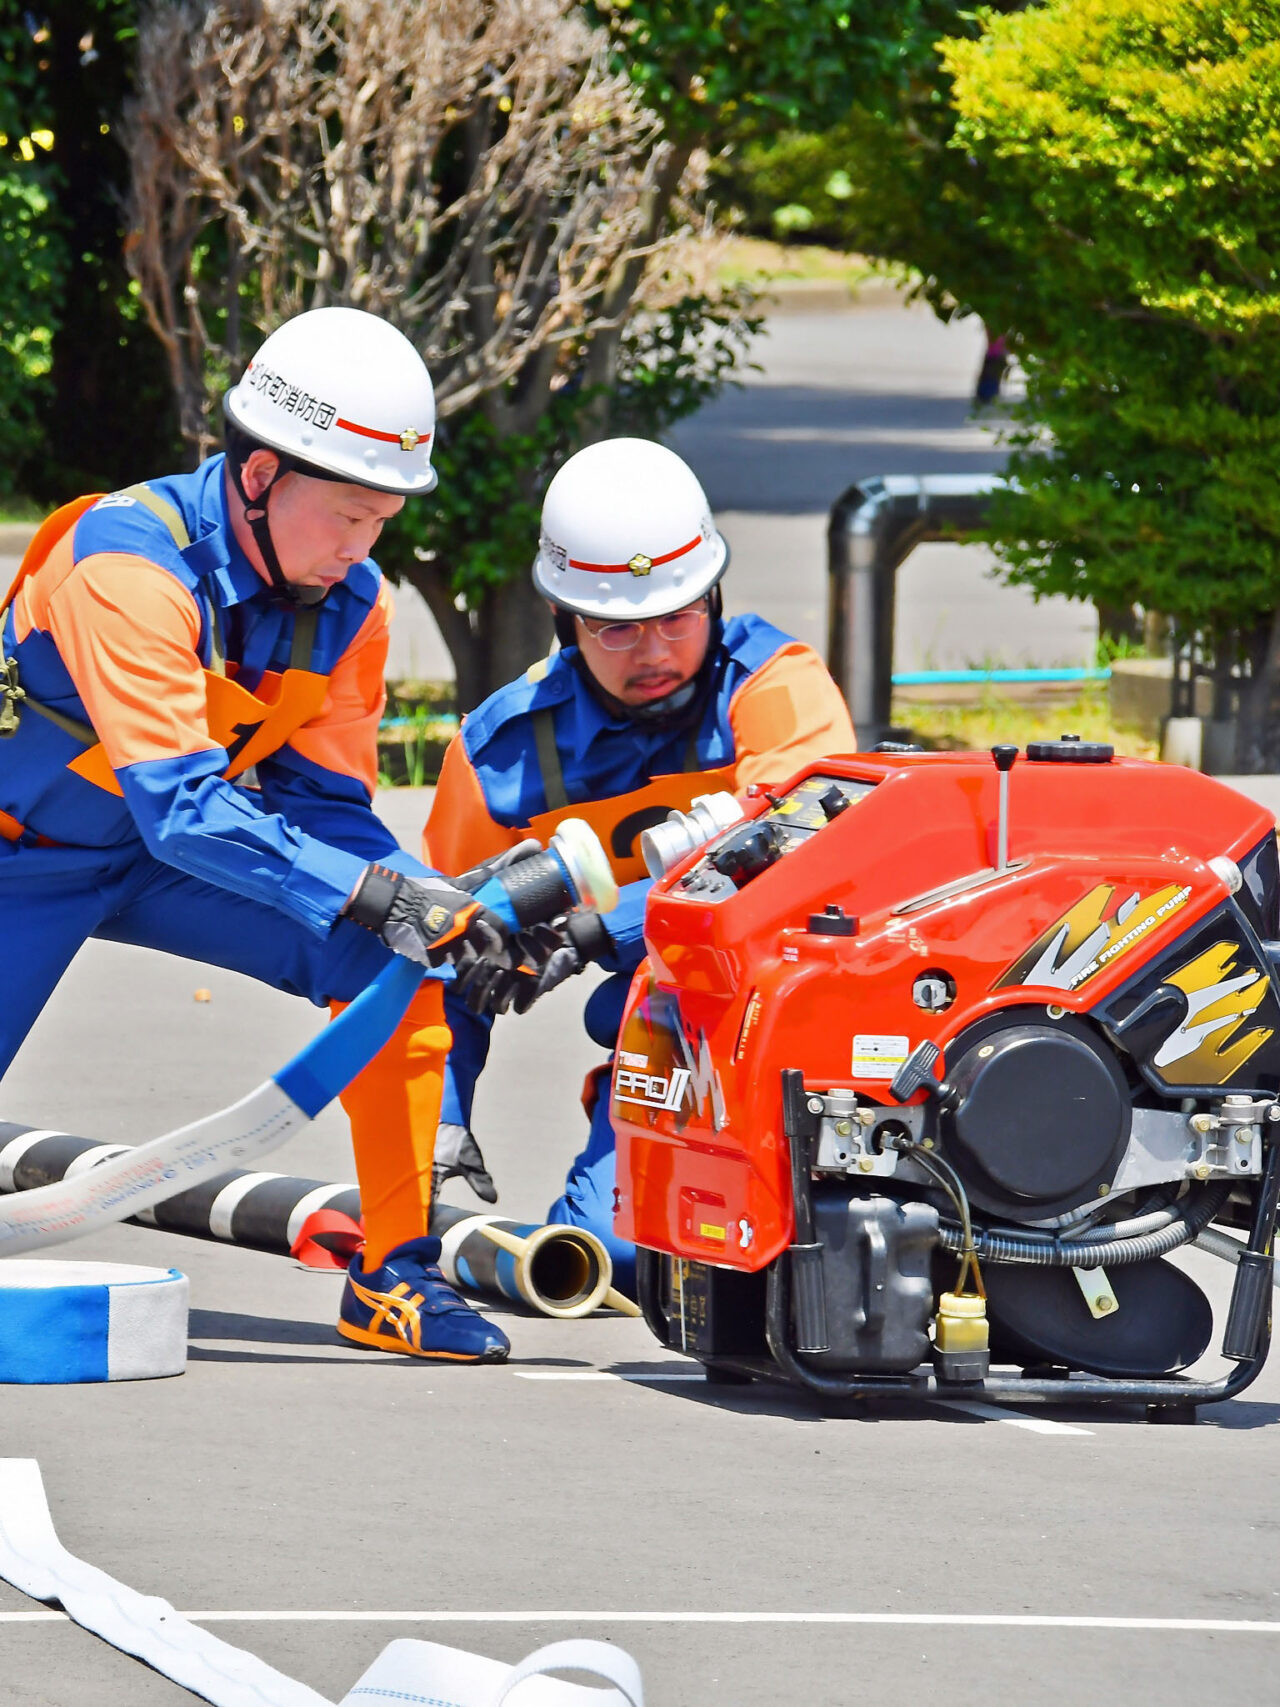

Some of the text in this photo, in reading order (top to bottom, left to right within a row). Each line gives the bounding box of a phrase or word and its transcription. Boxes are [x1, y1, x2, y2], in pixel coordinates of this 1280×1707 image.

[1070, 886, 1192, 986] FIRE FIGHTING PUMP
